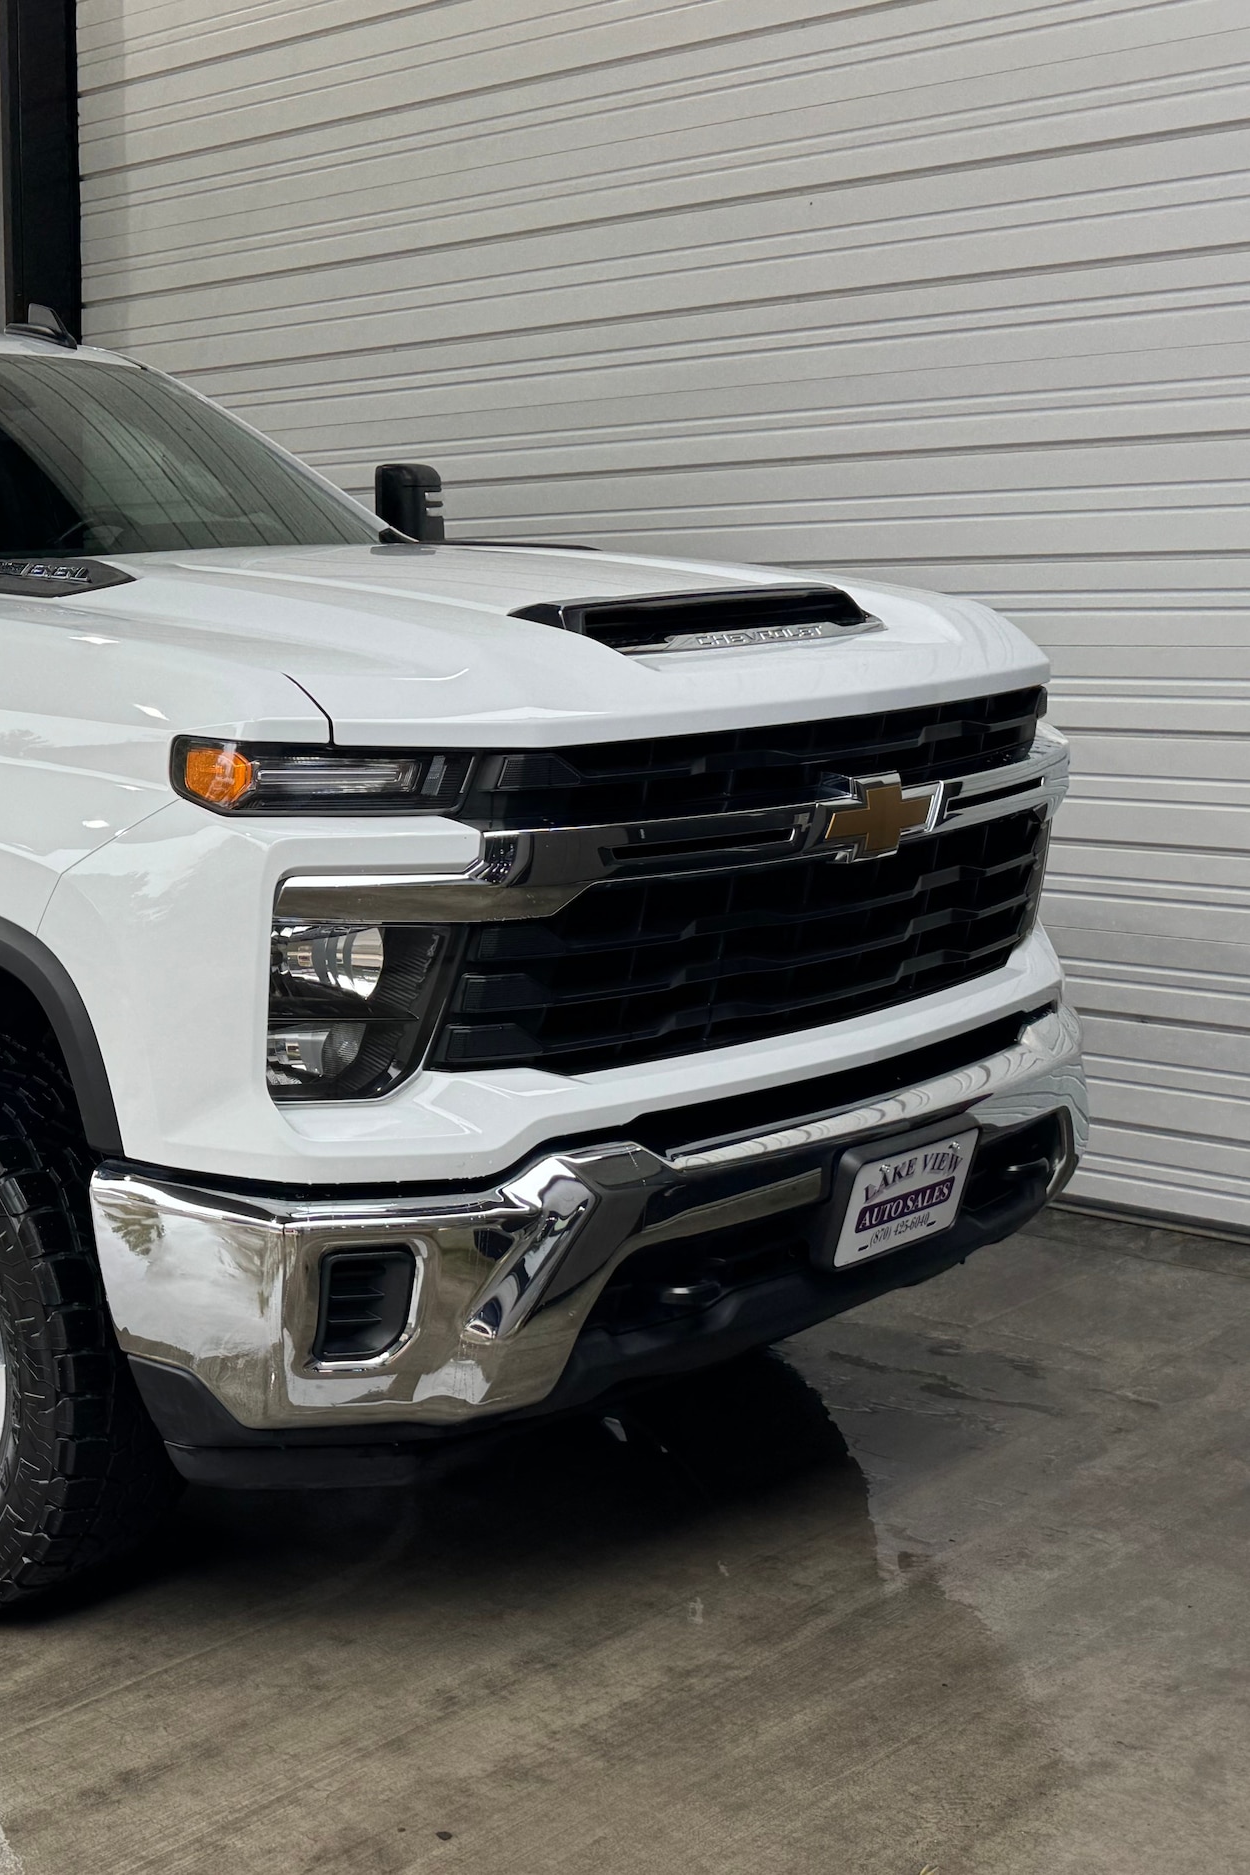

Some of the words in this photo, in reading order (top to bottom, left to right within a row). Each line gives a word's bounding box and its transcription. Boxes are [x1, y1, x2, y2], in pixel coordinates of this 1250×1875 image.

[696, 626, 823, 646] CHEVROLET
[863, 1157, 918, 1203] LAKE
[922, 1152, 963, 1175] VIEW
[859, 1199, 903, 1229] AUTO
[904, 1181, 951, 1213] SALES
[870, 1228, 891, 1247] (870)
